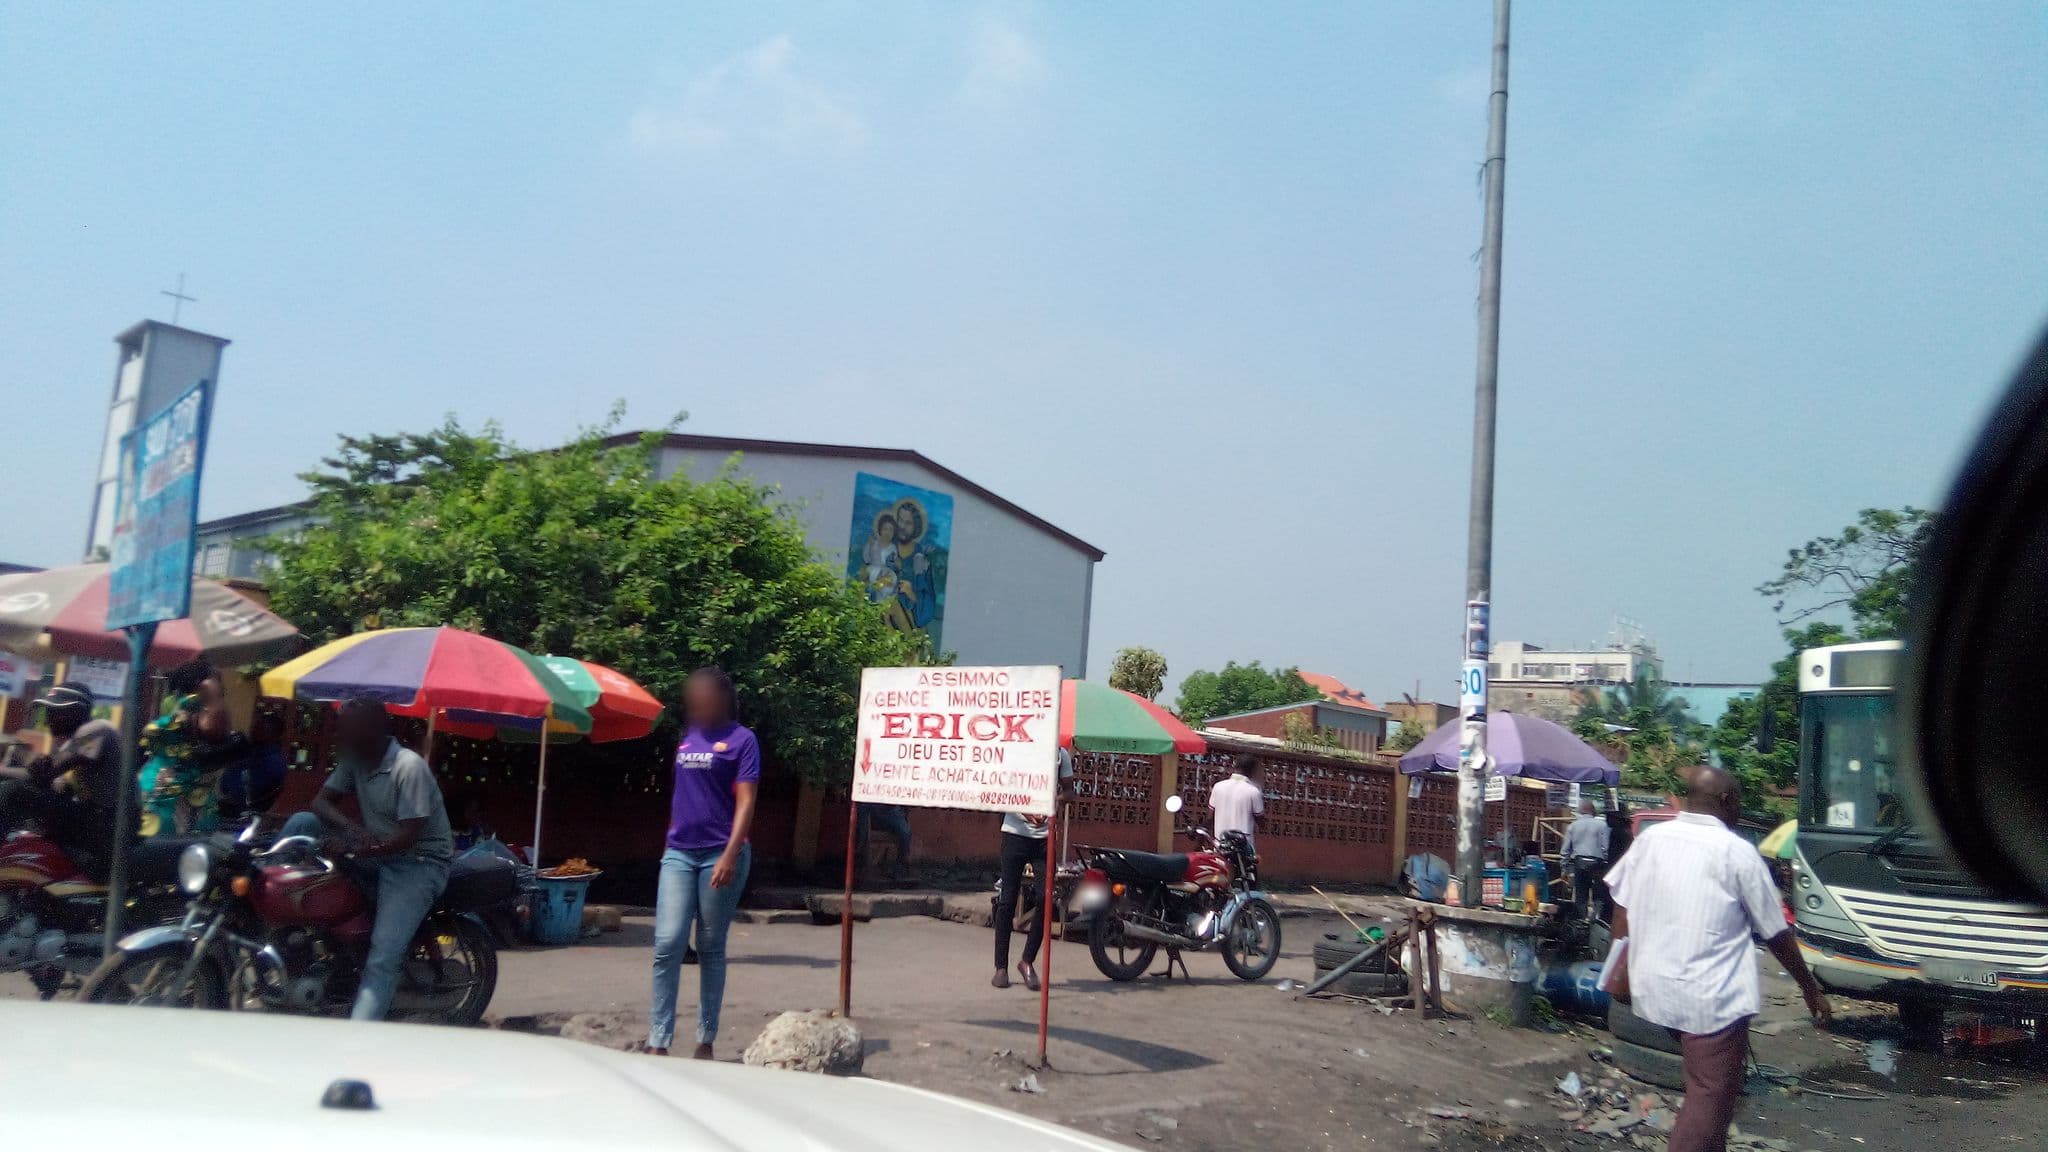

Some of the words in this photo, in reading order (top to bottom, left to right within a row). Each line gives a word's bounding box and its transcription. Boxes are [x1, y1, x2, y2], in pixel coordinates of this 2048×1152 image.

[918, 671, 1010, 687] ASSIMMO
[948, 690, 1052, 708] IMMOBILIERE
[898, 743, 933, 760] DIEU
[939, 745, 965, 761] EST
[972, 745, 1005, 764] BON
